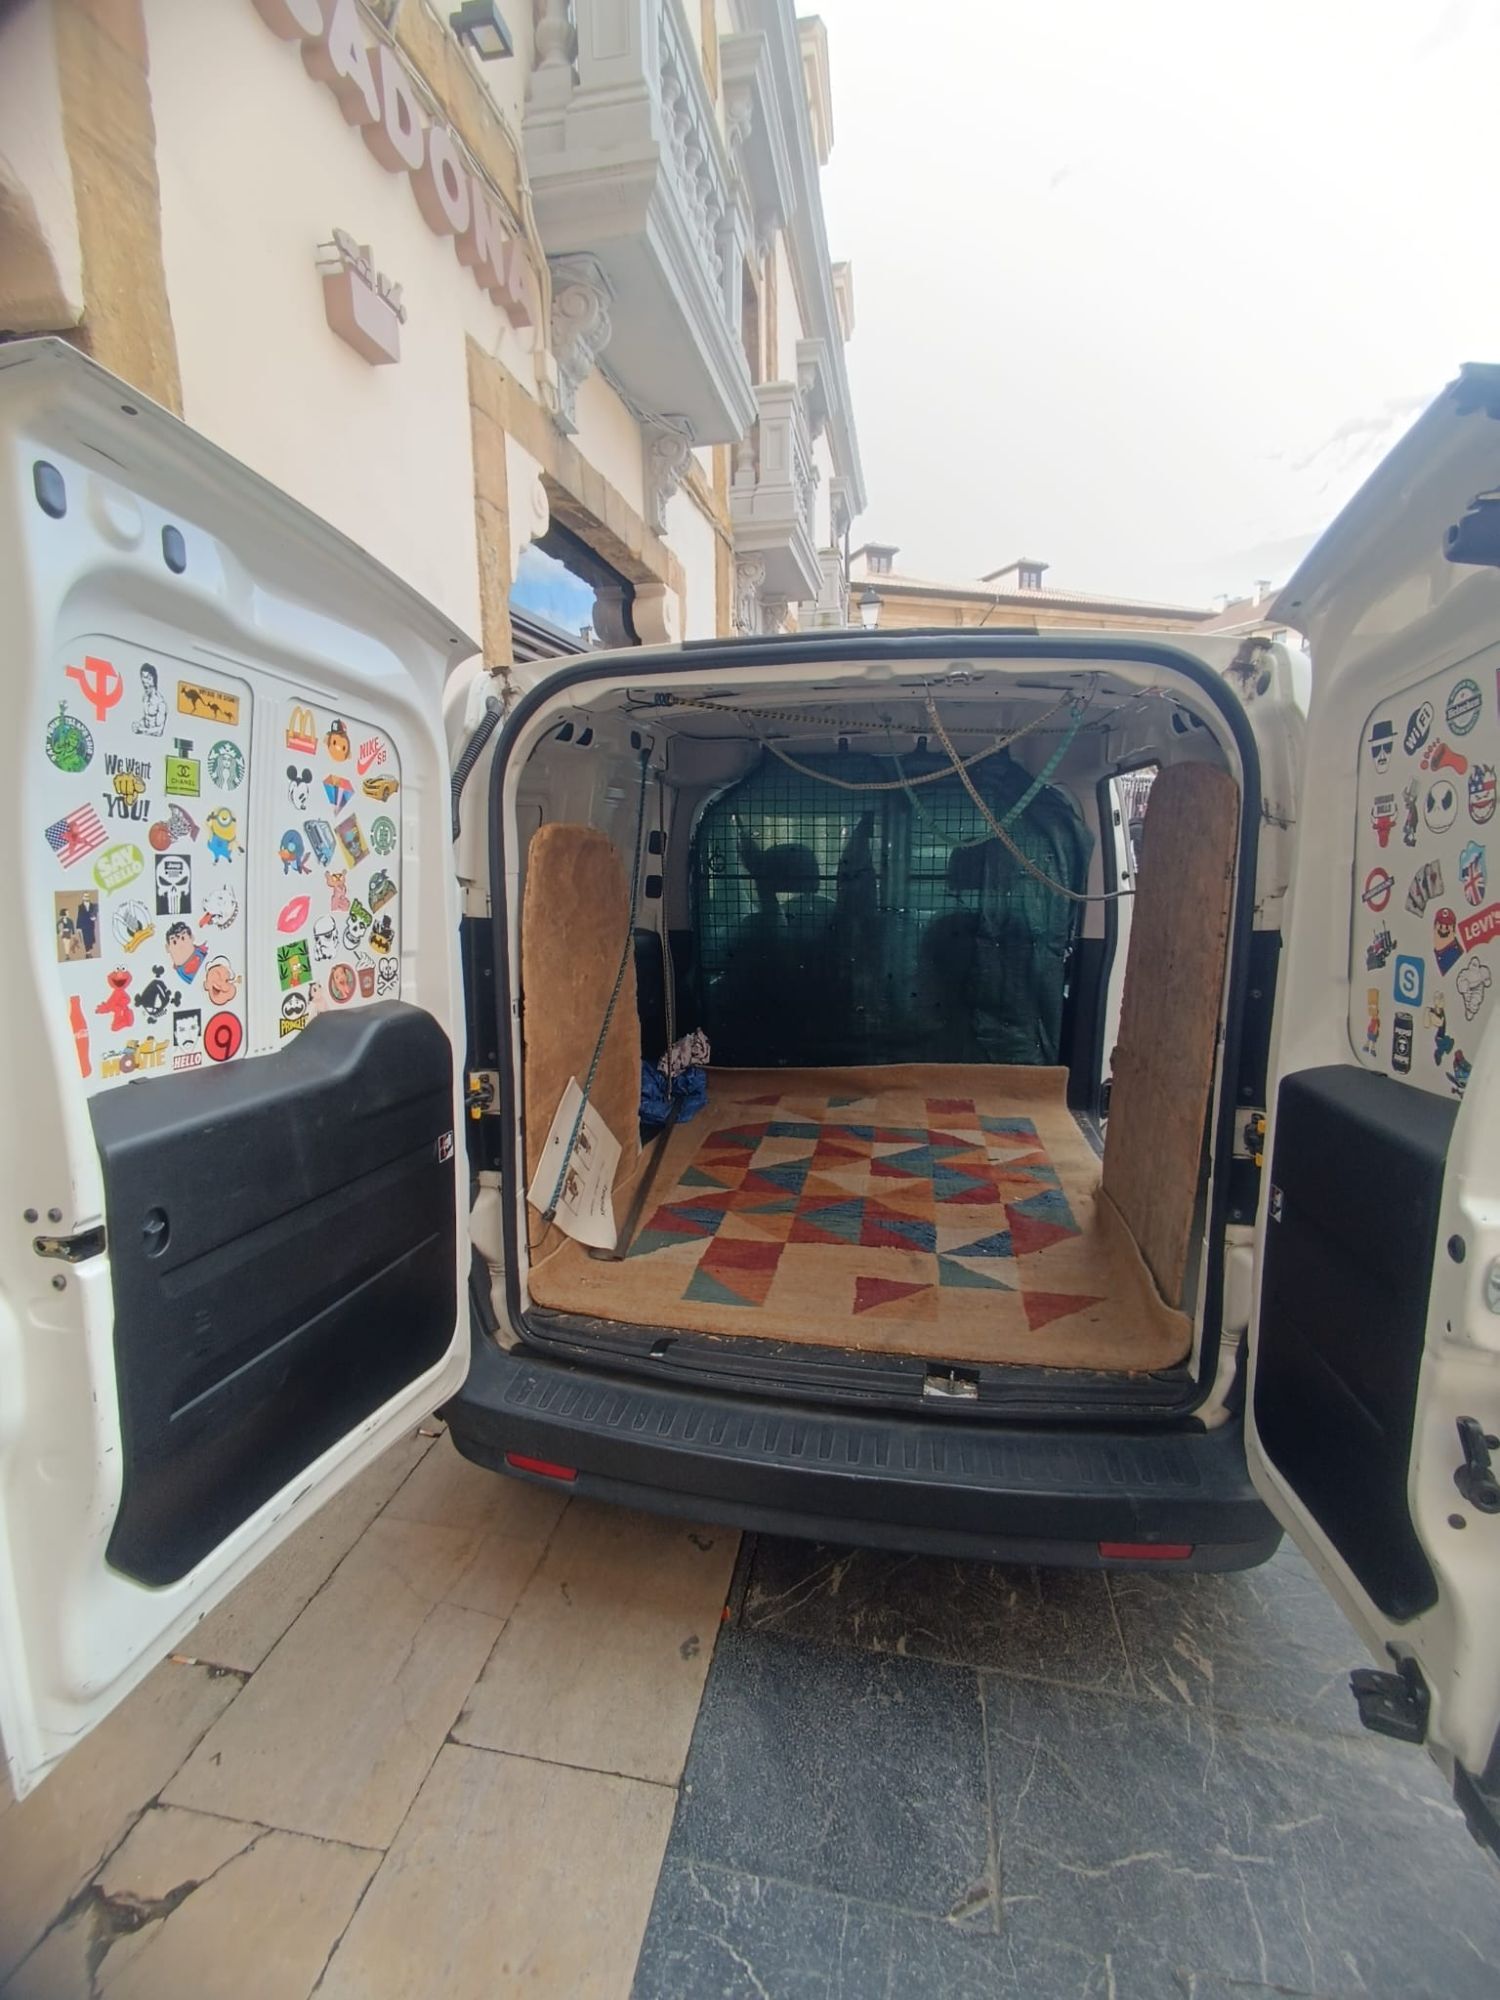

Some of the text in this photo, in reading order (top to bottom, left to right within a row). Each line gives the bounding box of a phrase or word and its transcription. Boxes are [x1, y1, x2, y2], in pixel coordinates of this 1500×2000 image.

[360, 736, 380, 760] NIKE
[377, 750, 387, 765] SB
[105, 752, 123, 775] We
[170, 778, 195, 786] CHANEL
[102, 793, 151, 822] YOU!
[97, 845, 133, 877] SAY
[104, 860, 141, 888] HELLO
[214, 1024, 233, 1060] 9
[174, 1054, 201, 1069] HELLO
